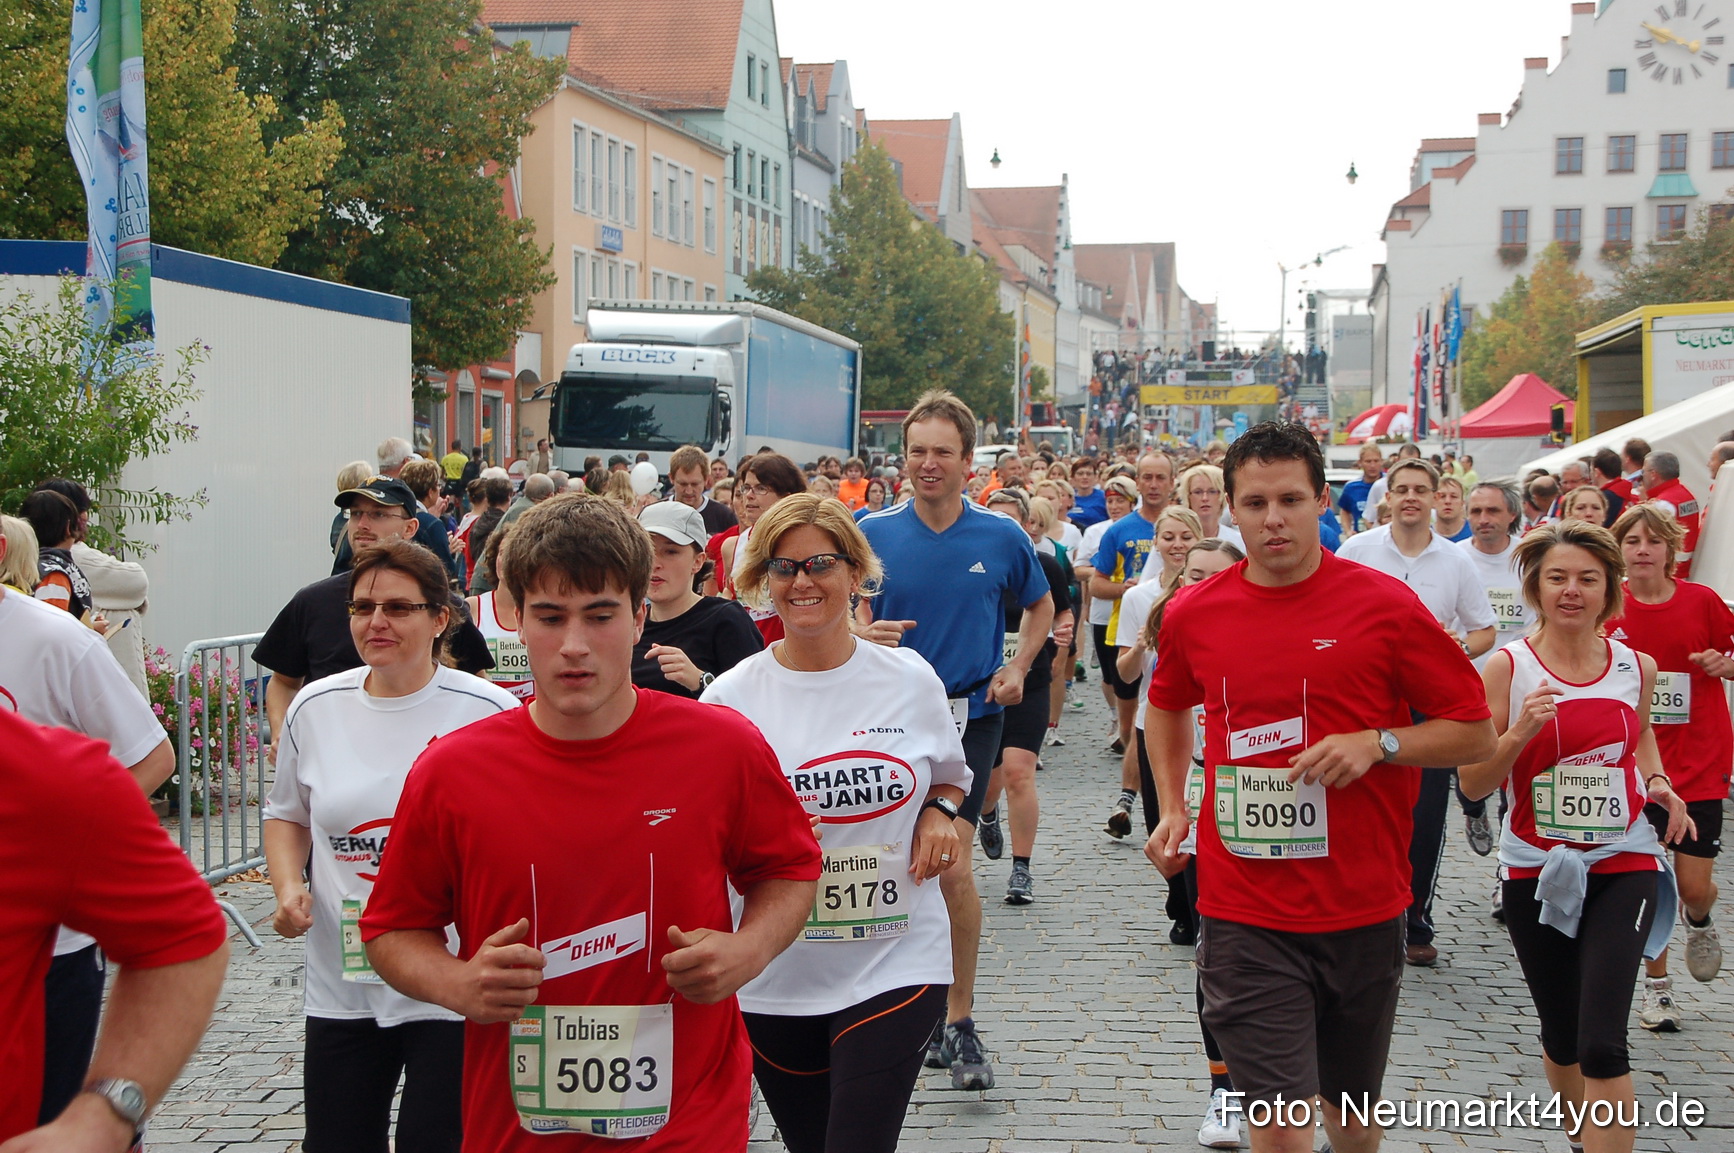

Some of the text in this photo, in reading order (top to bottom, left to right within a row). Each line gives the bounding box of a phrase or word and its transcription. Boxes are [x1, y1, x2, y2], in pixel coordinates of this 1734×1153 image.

[602, 349, 676, 364] BOCK
[1184, 389, 1231, 401] START
[1488, 590, 1512, 600] Robert
[500, 641, 526, 651] Bettina
[502, 655, 529, 667] 508
[1248, 730, 1282, 748] DEHN
[1574, 752, 1606, 766] DEHN
[889, 769, 899, 780] &
[1559, 771, 1610, 790] Irmgard
[1242, 774, 1294, 792] Markus
[819, 783, 904, 810] JÄNIG
[1536, 793, 1543, 804] S
[643, 808, 677, 816] BROOKS
[1219, 800, 1225, 813] S
[1561, 795, 1621, 818] 5078
[1245, 802, 1316, 828] 5090
[1283, 842, 1326, 852] PFLEIDERER
[820, 855, 878, 873] Martina
[824, 879, 899, 911] 5178
[866, 920, 909, 933] PFLEIDERER
[570, 932, 617, 962] DEHN
[553, 1015, 620, 1041] Tobias
[517, 1055, 526, 1073] S
[556, 1056, 659, 1094] 5083
[530, 1118, 569, 1128] BOCK
[609, 1114, 666, 1128] PFLEIDERER
